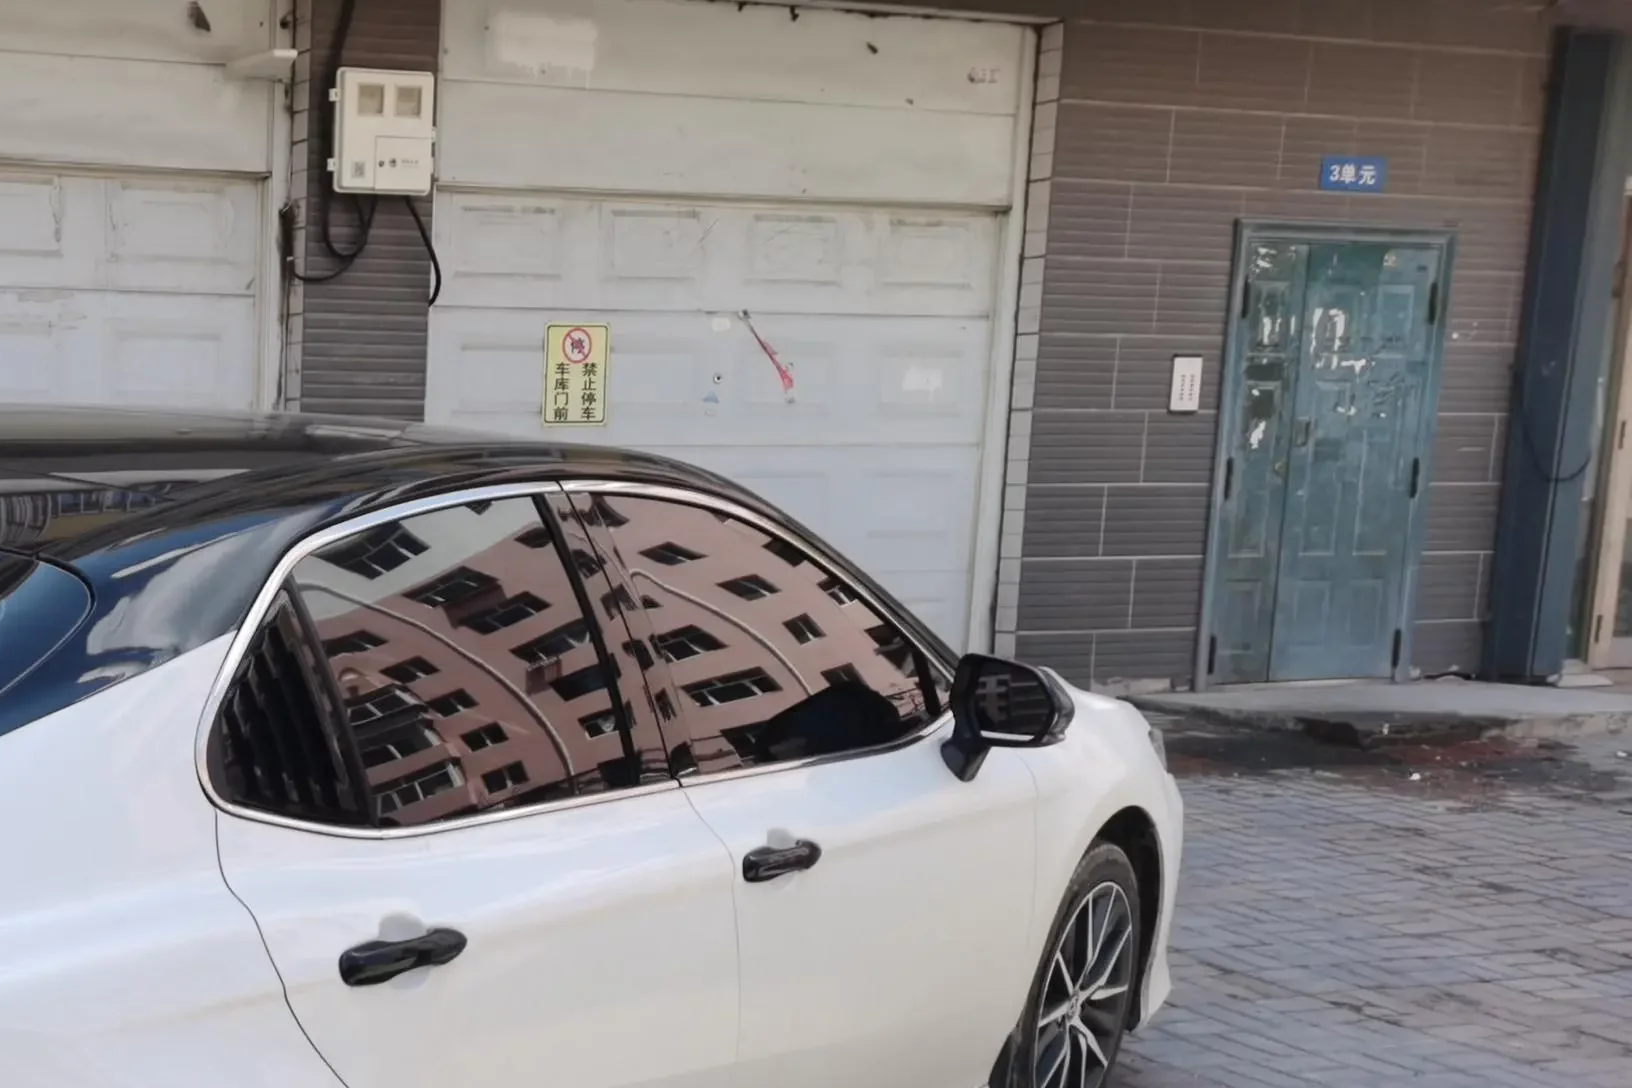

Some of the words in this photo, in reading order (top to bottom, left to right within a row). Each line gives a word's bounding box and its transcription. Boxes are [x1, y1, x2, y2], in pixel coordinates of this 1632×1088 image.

[1329, 163, 1376, 185] 3单元
[554, 362, 570, 420] 车库门前
[581, 362, 597, 420] 禁止停车
